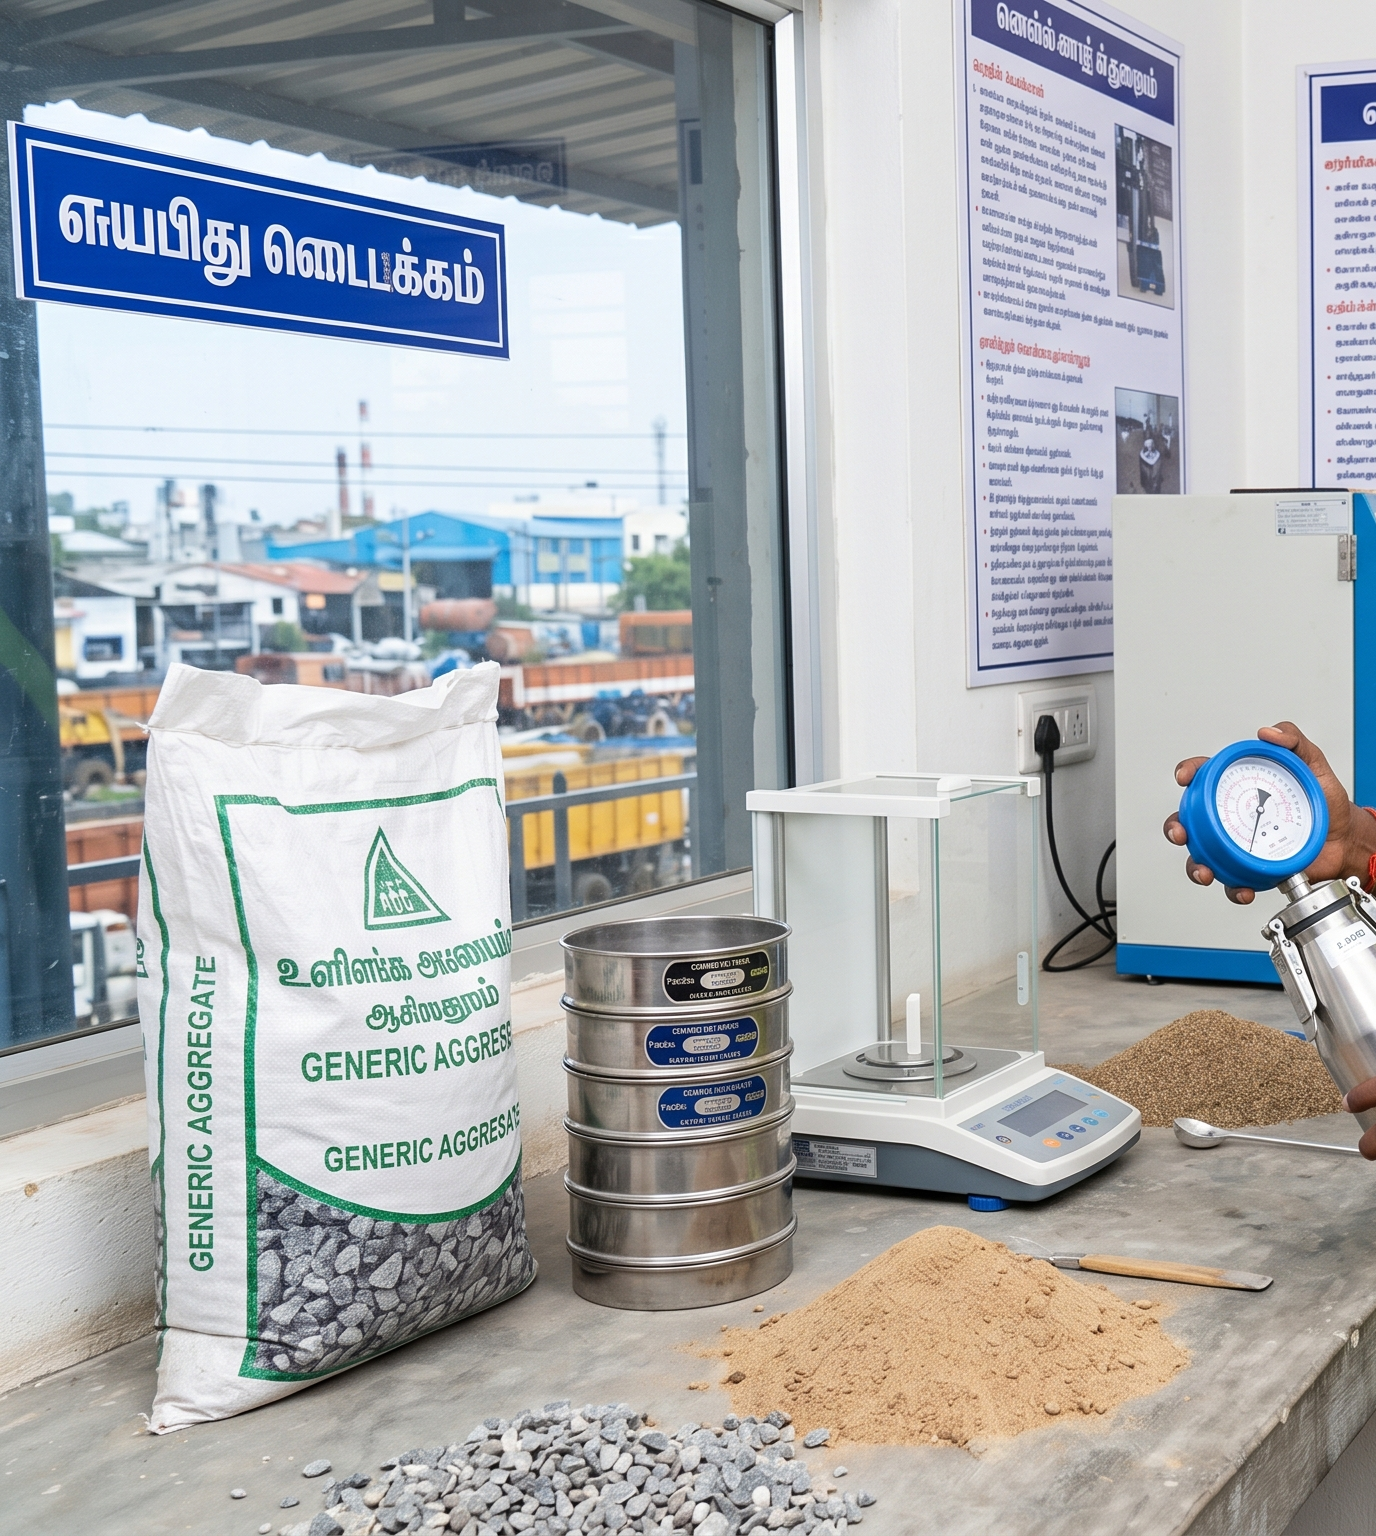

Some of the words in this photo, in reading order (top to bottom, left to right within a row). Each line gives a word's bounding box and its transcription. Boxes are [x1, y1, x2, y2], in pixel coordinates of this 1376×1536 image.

[187, 956, 217, 1135] AGGREGATE
[301, 1045, 428, 1083] GENERIC
[324, 1138, 433, 1173] GENERIC
[187, 1143, 215, 1272] GENERIC
